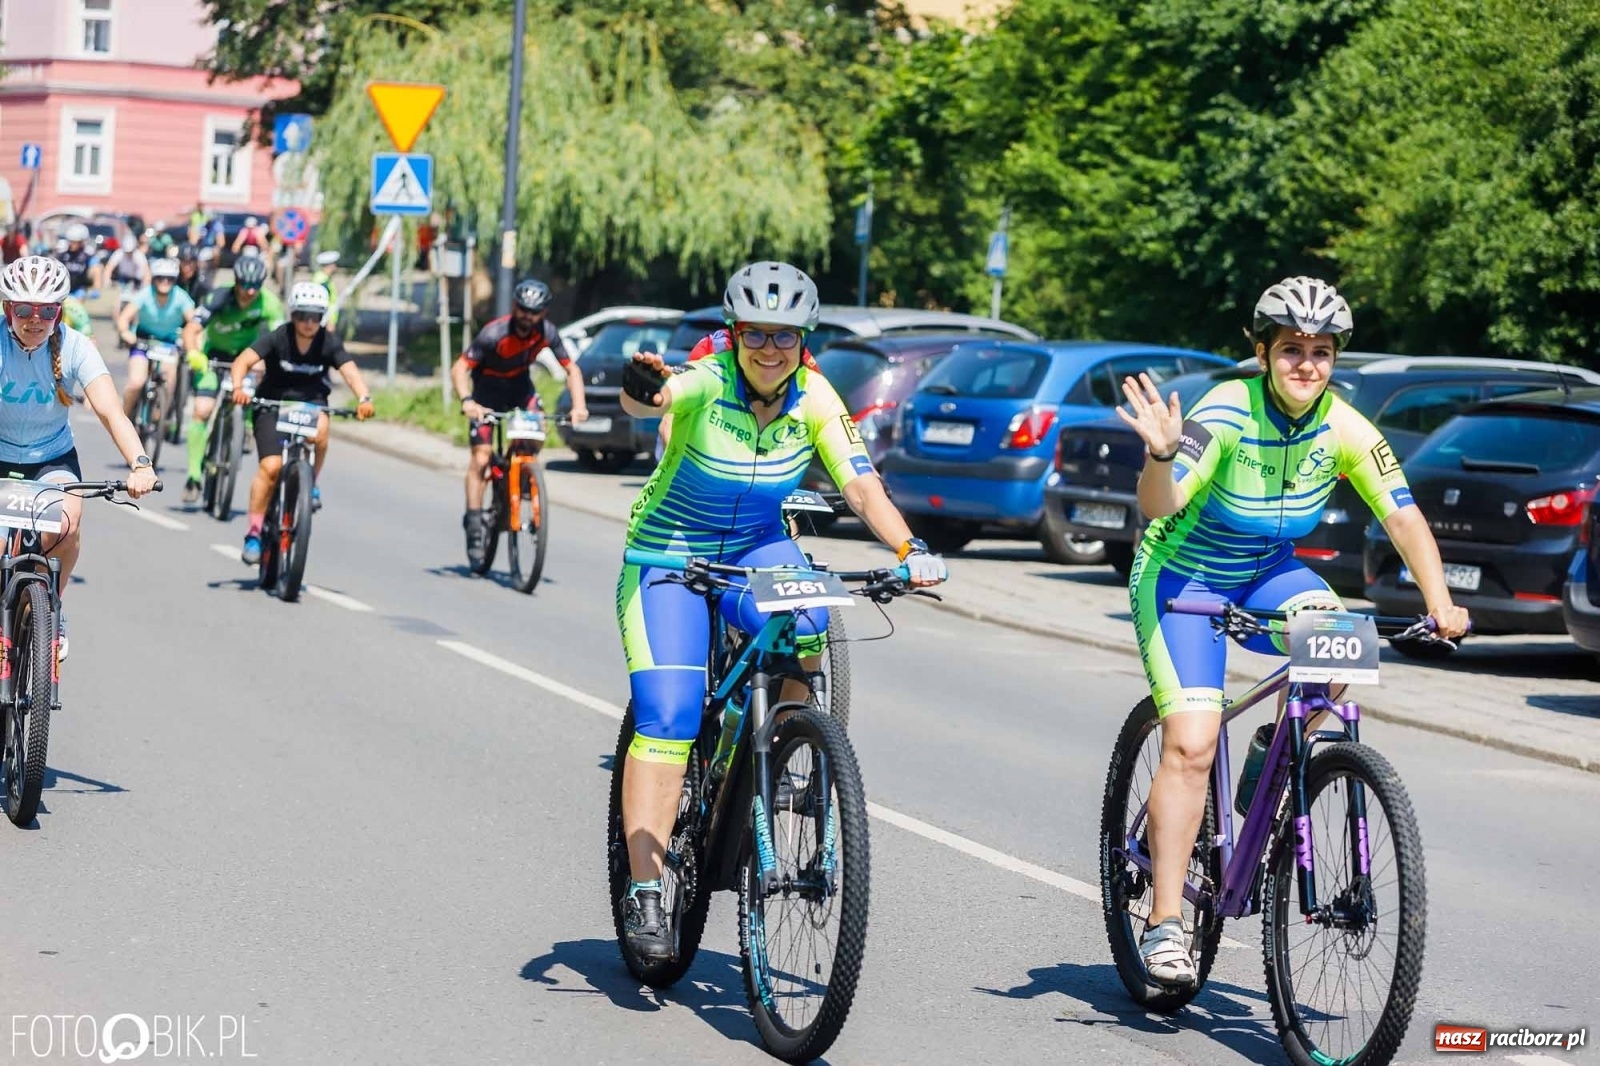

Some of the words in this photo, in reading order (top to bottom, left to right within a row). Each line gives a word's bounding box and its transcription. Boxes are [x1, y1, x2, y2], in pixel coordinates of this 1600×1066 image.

[708, 410, 752, 442] Energo
[1236, 449, 1276, 478] Energo
[7, 494, 48, 514] 2132
[773, 581, 828, 596] 1261
[1306, 635, 1362, 661] 1260
[1265, 874, 1275, 923] BARZO
